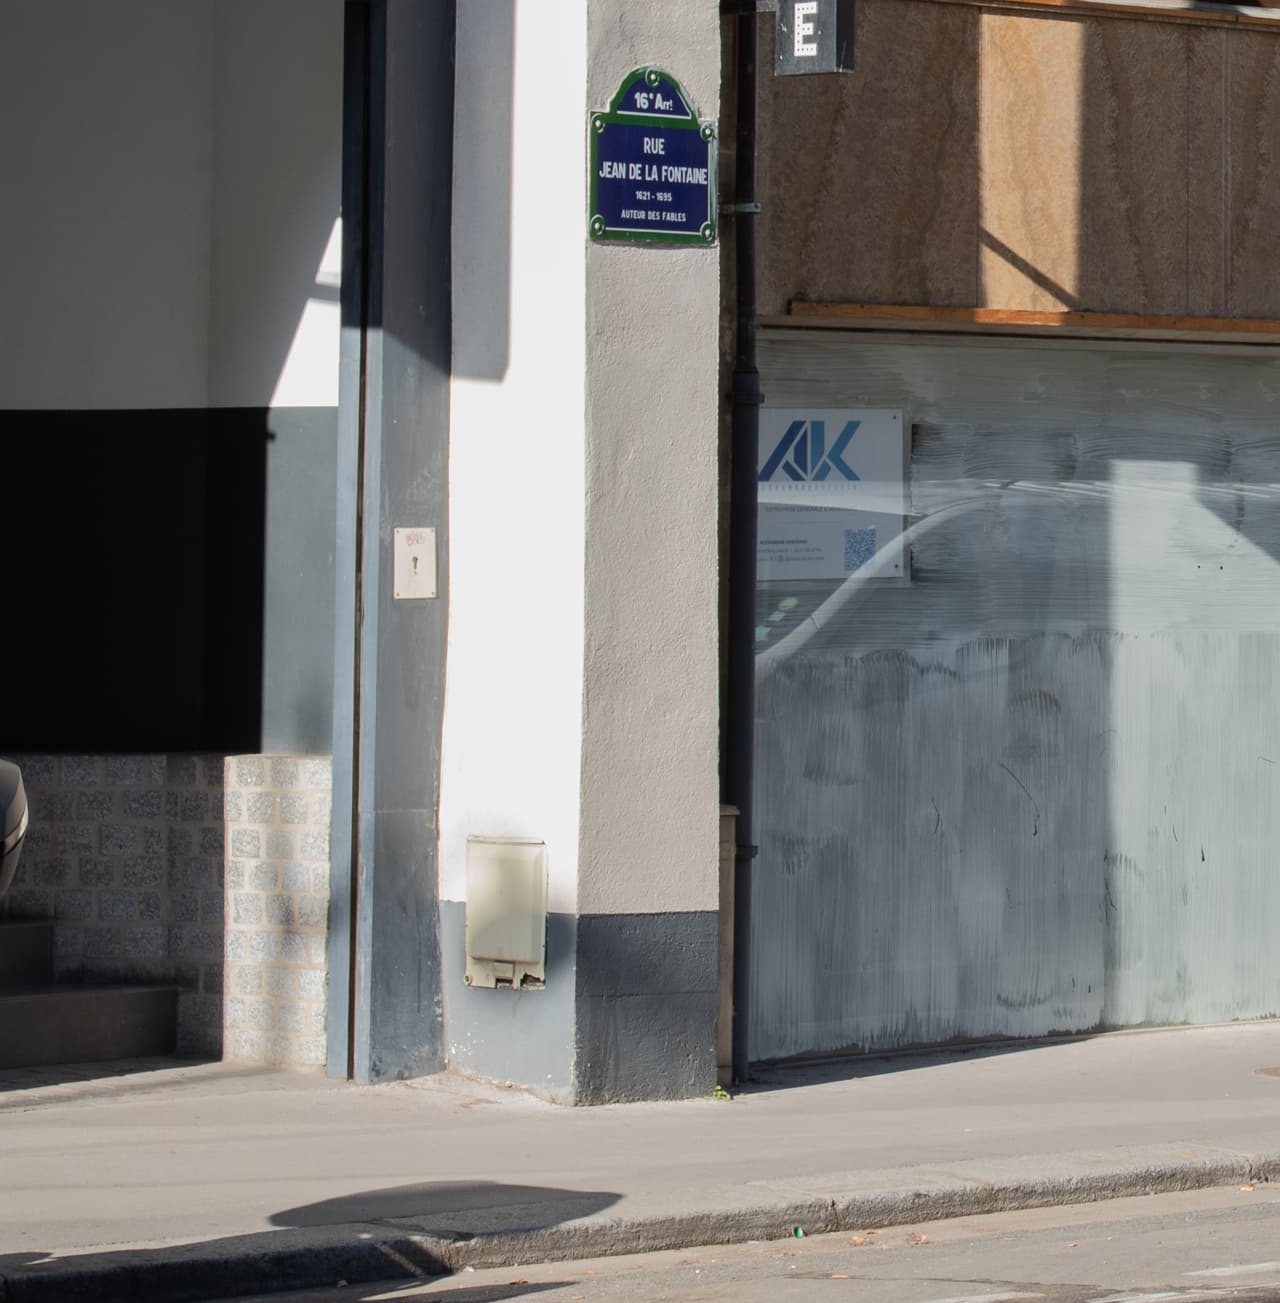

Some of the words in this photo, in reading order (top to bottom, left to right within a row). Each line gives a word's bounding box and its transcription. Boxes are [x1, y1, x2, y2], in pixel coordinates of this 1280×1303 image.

[643, 137, 665, 155] RUE
[599, 161, 626, 179] JEAN
[629, 163, 642, 180] DE
[645, 164, 658, 182] LA
[661, 165, 708, 185] FONTAINE
[635, 191, 650, 200] 1621
[621, 209, 646, 220] AUTEUR
[648, 210, 661, 221] DES
[662, 211, 687, 222] FABLES
